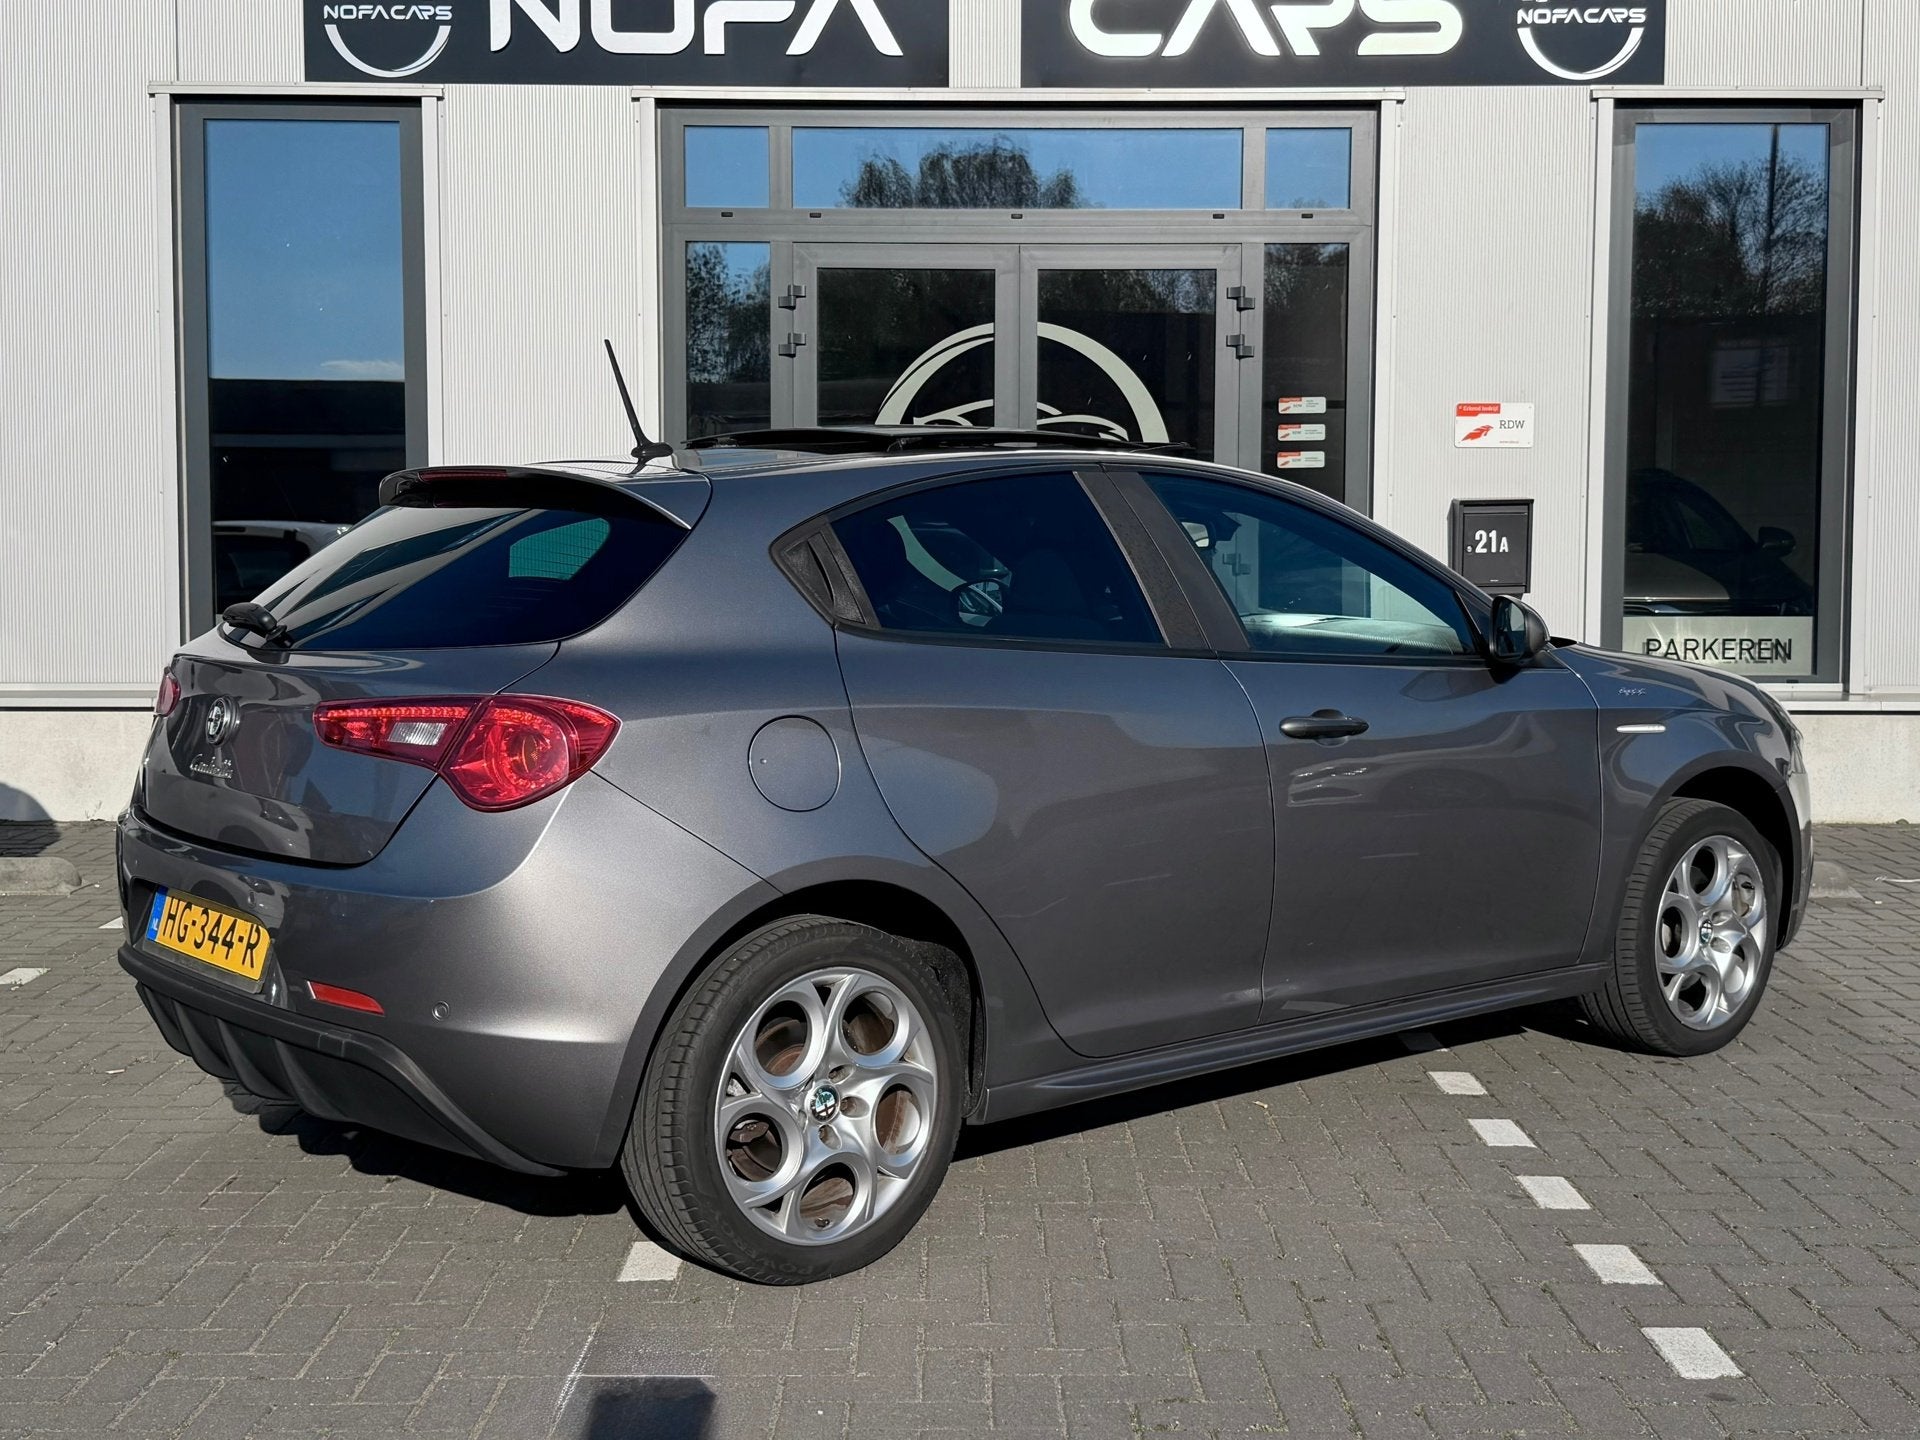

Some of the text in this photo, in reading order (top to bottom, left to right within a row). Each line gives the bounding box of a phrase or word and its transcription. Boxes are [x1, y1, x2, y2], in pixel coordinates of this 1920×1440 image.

[490, 0, 903, 57] NOFA
[1069, 0, 1463, 57] CARS
[1499, 419, 1525, 430] RDW
[1645, 638, 1793, 661] PARKEREN
[162, 896, 261, 969] HG-344-R
